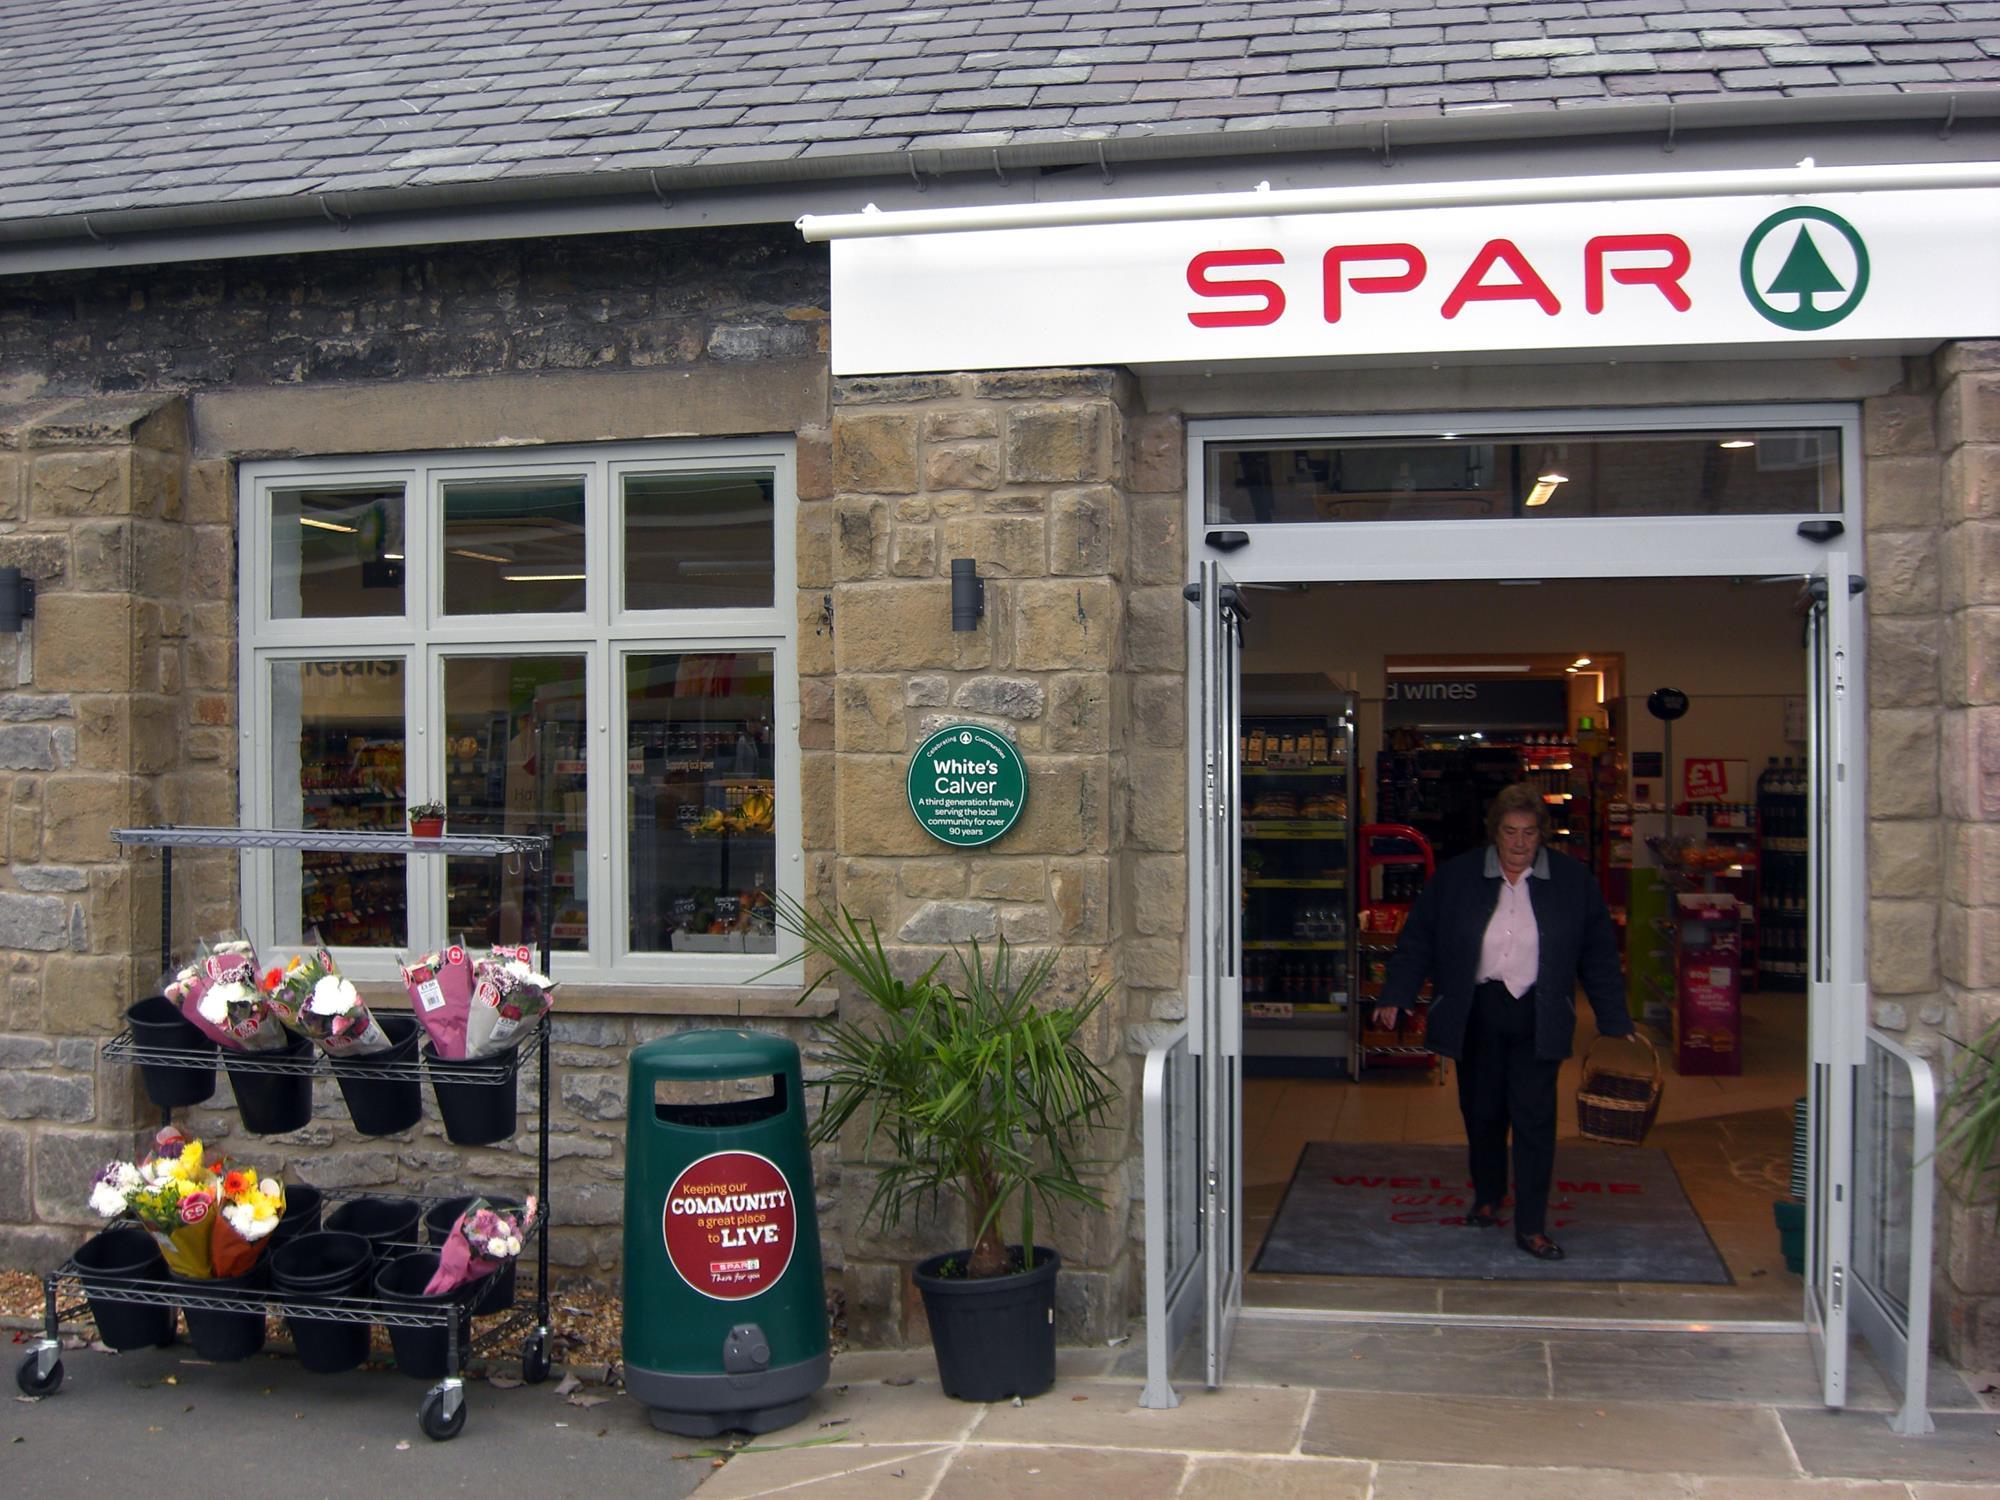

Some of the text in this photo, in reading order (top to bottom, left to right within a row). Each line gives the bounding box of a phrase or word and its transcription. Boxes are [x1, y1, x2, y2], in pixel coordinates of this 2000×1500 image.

[1186, 233, 1691, 328] SPAR
[1403, 682, 1478, 700] wines
[926, 735, 1006, 759] Celebrating Communities
[933, 759, 998, 774] White's
[1688, 761, 1721, 786] £1
[934, 776, 998, 794] Calver
[1691, 785, 1723, 796] value
[918, 798, 925, 806] A
[925, 798, 944, 806] third
[945, 798, 988, 808] generation
[934, 808, 998, 817] serving the local
[928, 817, 973, 827] community
[973, 818, 986, 826] for
[948, 827, 984, 837] 90 years
[683, 1183, 748, 1196] Keeping our
[1331, 1176, 1643, 1195] WELME
[671, 1190, 787, 1215] COMMUNITY
[186, 1206, 205, 1220] £5
[697, 1213, 766, 1229] a great place
[707, 1224, 779, 1248] to LIVE
[720, 1262, 749, 1271] SPAR
